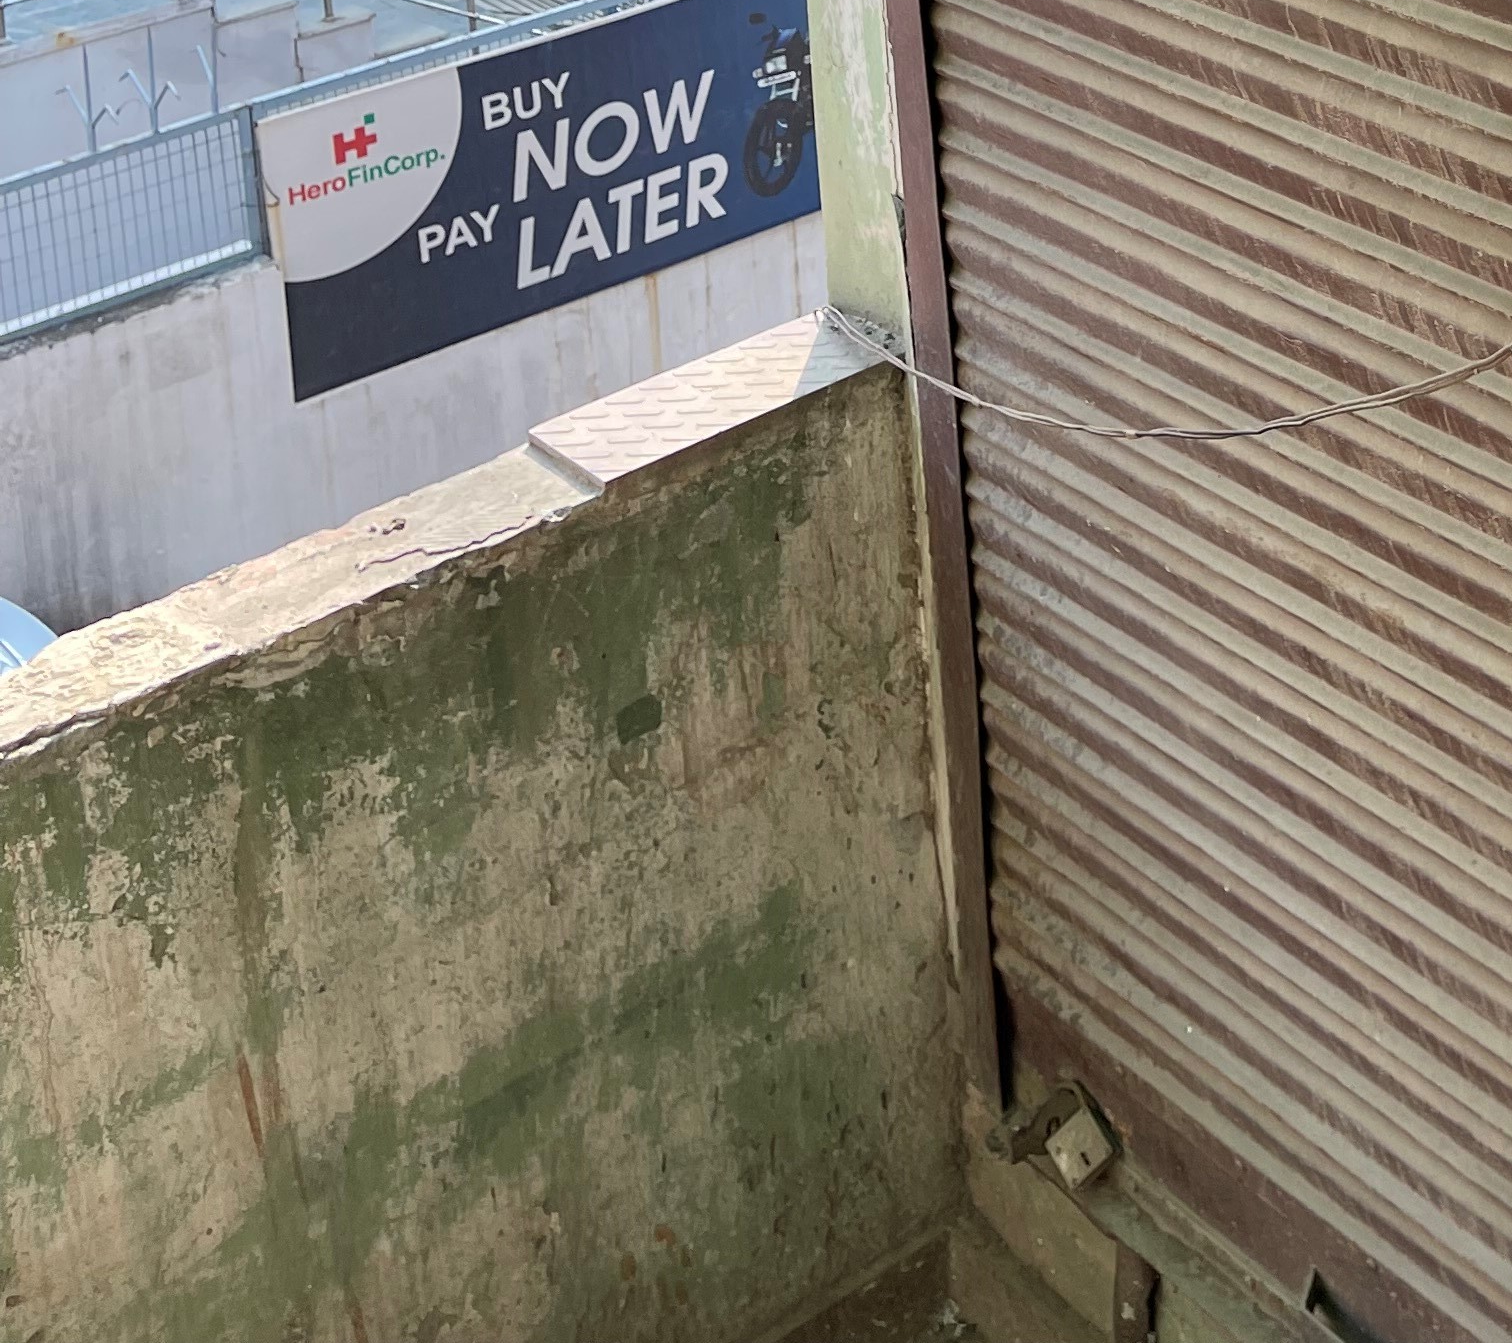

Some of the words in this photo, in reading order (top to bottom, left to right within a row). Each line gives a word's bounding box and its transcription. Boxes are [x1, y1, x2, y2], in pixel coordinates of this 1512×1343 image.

[481, 71, 571, 131] BUY
[512, 69, 715, 204] NOW
[417, 204, 500, 264] PAY
[516, 152, 730, 290] LATER
